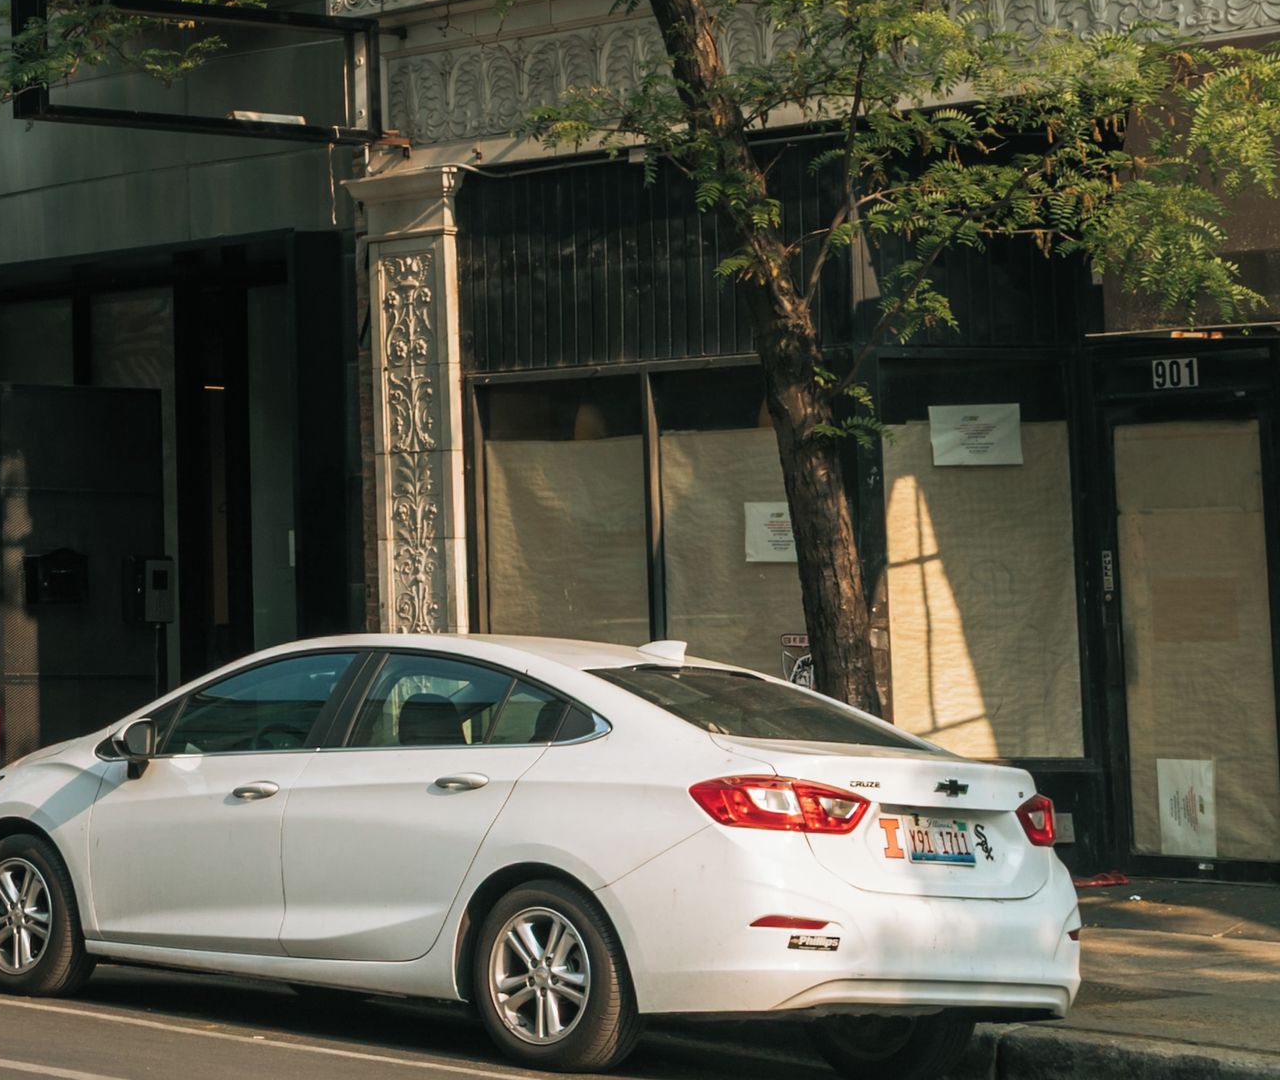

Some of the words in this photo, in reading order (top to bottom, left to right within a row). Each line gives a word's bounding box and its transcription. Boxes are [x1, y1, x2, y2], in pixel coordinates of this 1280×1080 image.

[1154, 359, 1196, 388] 901
[850, 780, 881, 788] CRUZE
[940, 831, 972, 856] 1711
[799, 935, 839, 948] Phillips
